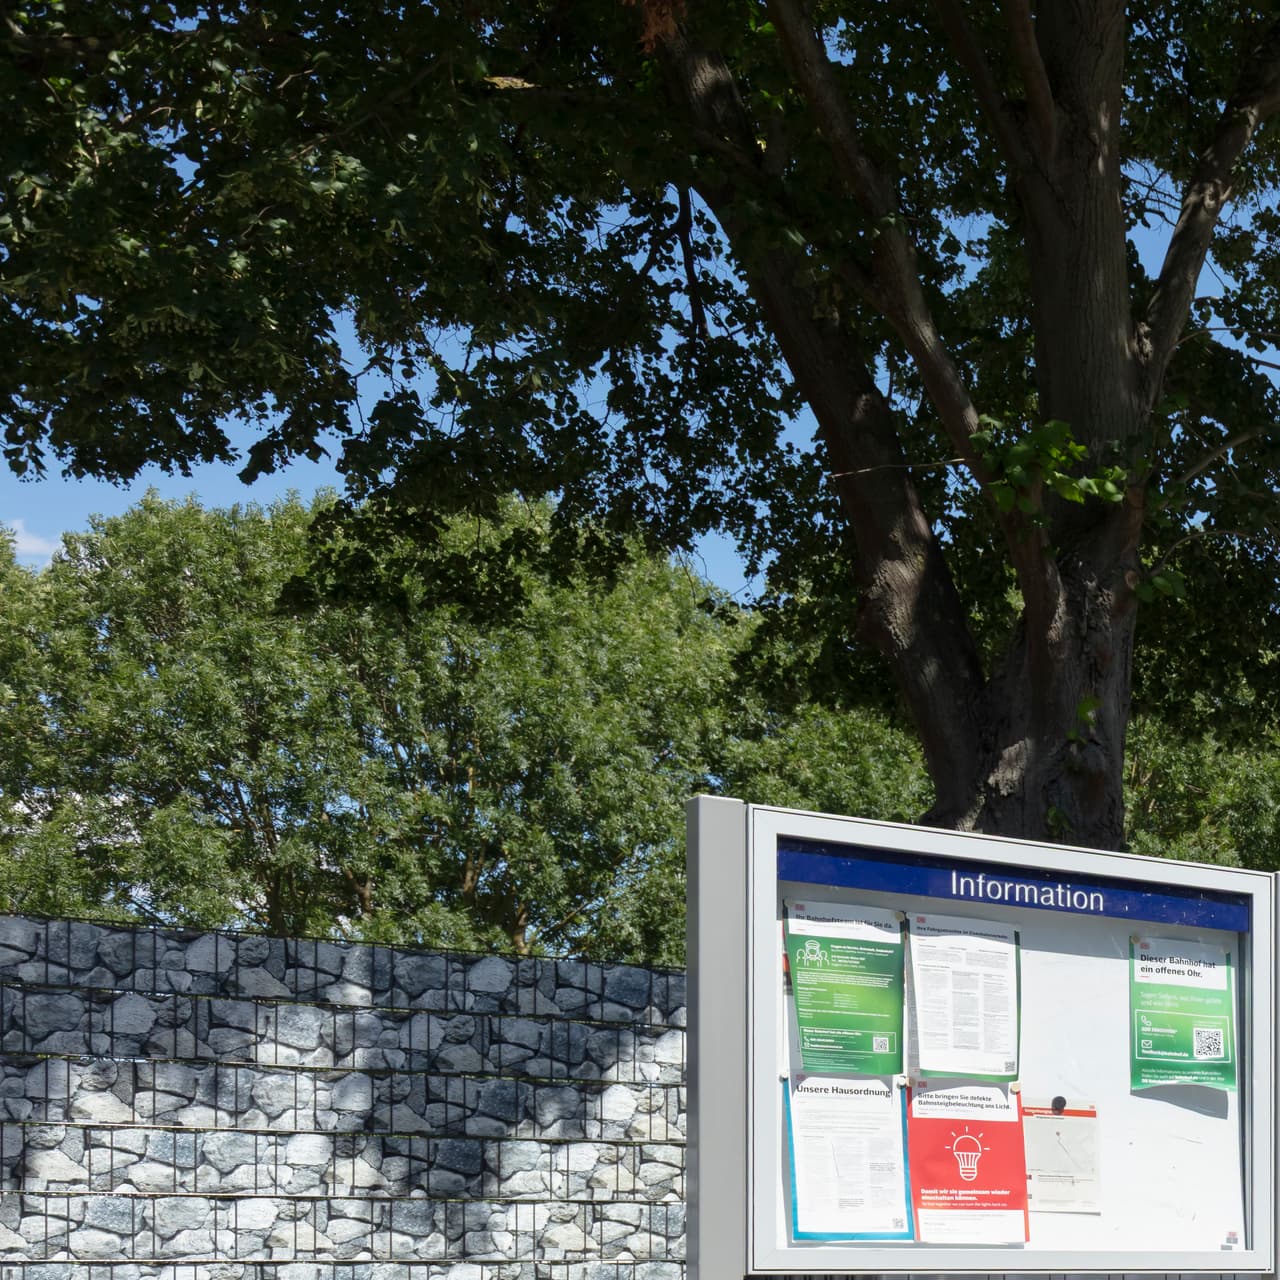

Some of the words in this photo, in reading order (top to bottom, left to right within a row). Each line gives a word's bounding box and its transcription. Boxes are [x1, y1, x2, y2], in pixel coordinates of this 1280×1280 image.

[952, 869, 1104, 912] Information
[1140, 954, 1167, 963] Dieser
[1169, 956, 1202, 967] Bahnhof
[1203, 961, 1216, 969] hat
[1140, 965, 1154, 973] ein
[1155, 966, 1186, 975] offenes
[796, 1085, 830, 1095] Unsere
[831, 1086, 892, 1098] Hausordnung
[934, 1093, 959, 1101] bringen
